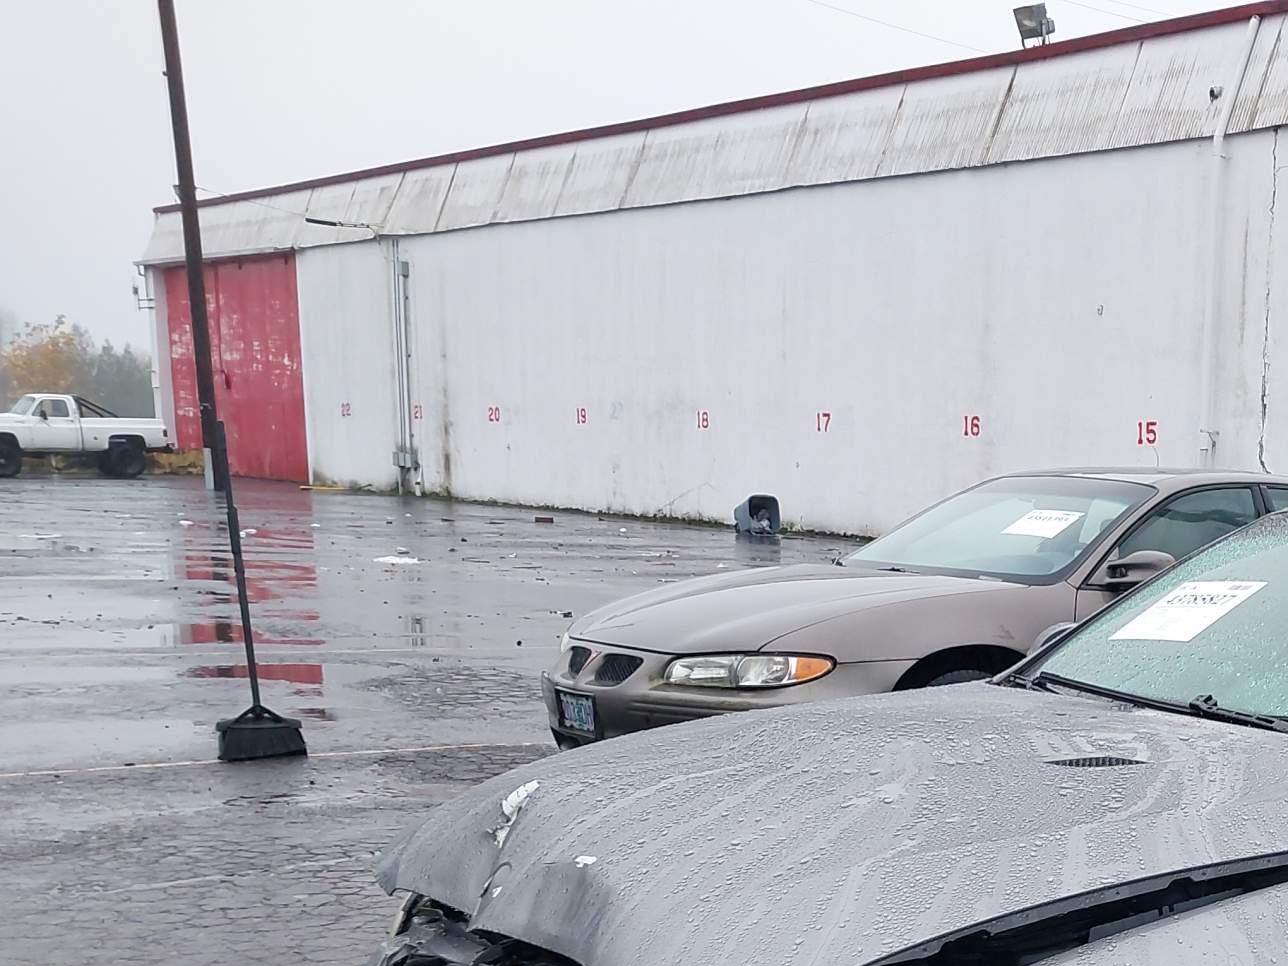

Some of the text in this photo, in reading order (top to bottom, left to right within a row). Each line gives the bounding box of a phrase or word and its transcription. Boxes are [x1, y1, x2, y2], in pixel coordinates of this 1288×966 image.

[340, 402, 352, 417] 22
[413, 404, 423, 420] 21
[488, 406, 501, 422] 20
[576, 407, 587, 424] 19
[696, 411, 710, 429] 18
[816, 412, 831, 433] 17
[963, 415, 981, 437] 16
[1137, 421, 1158, 449] 15
